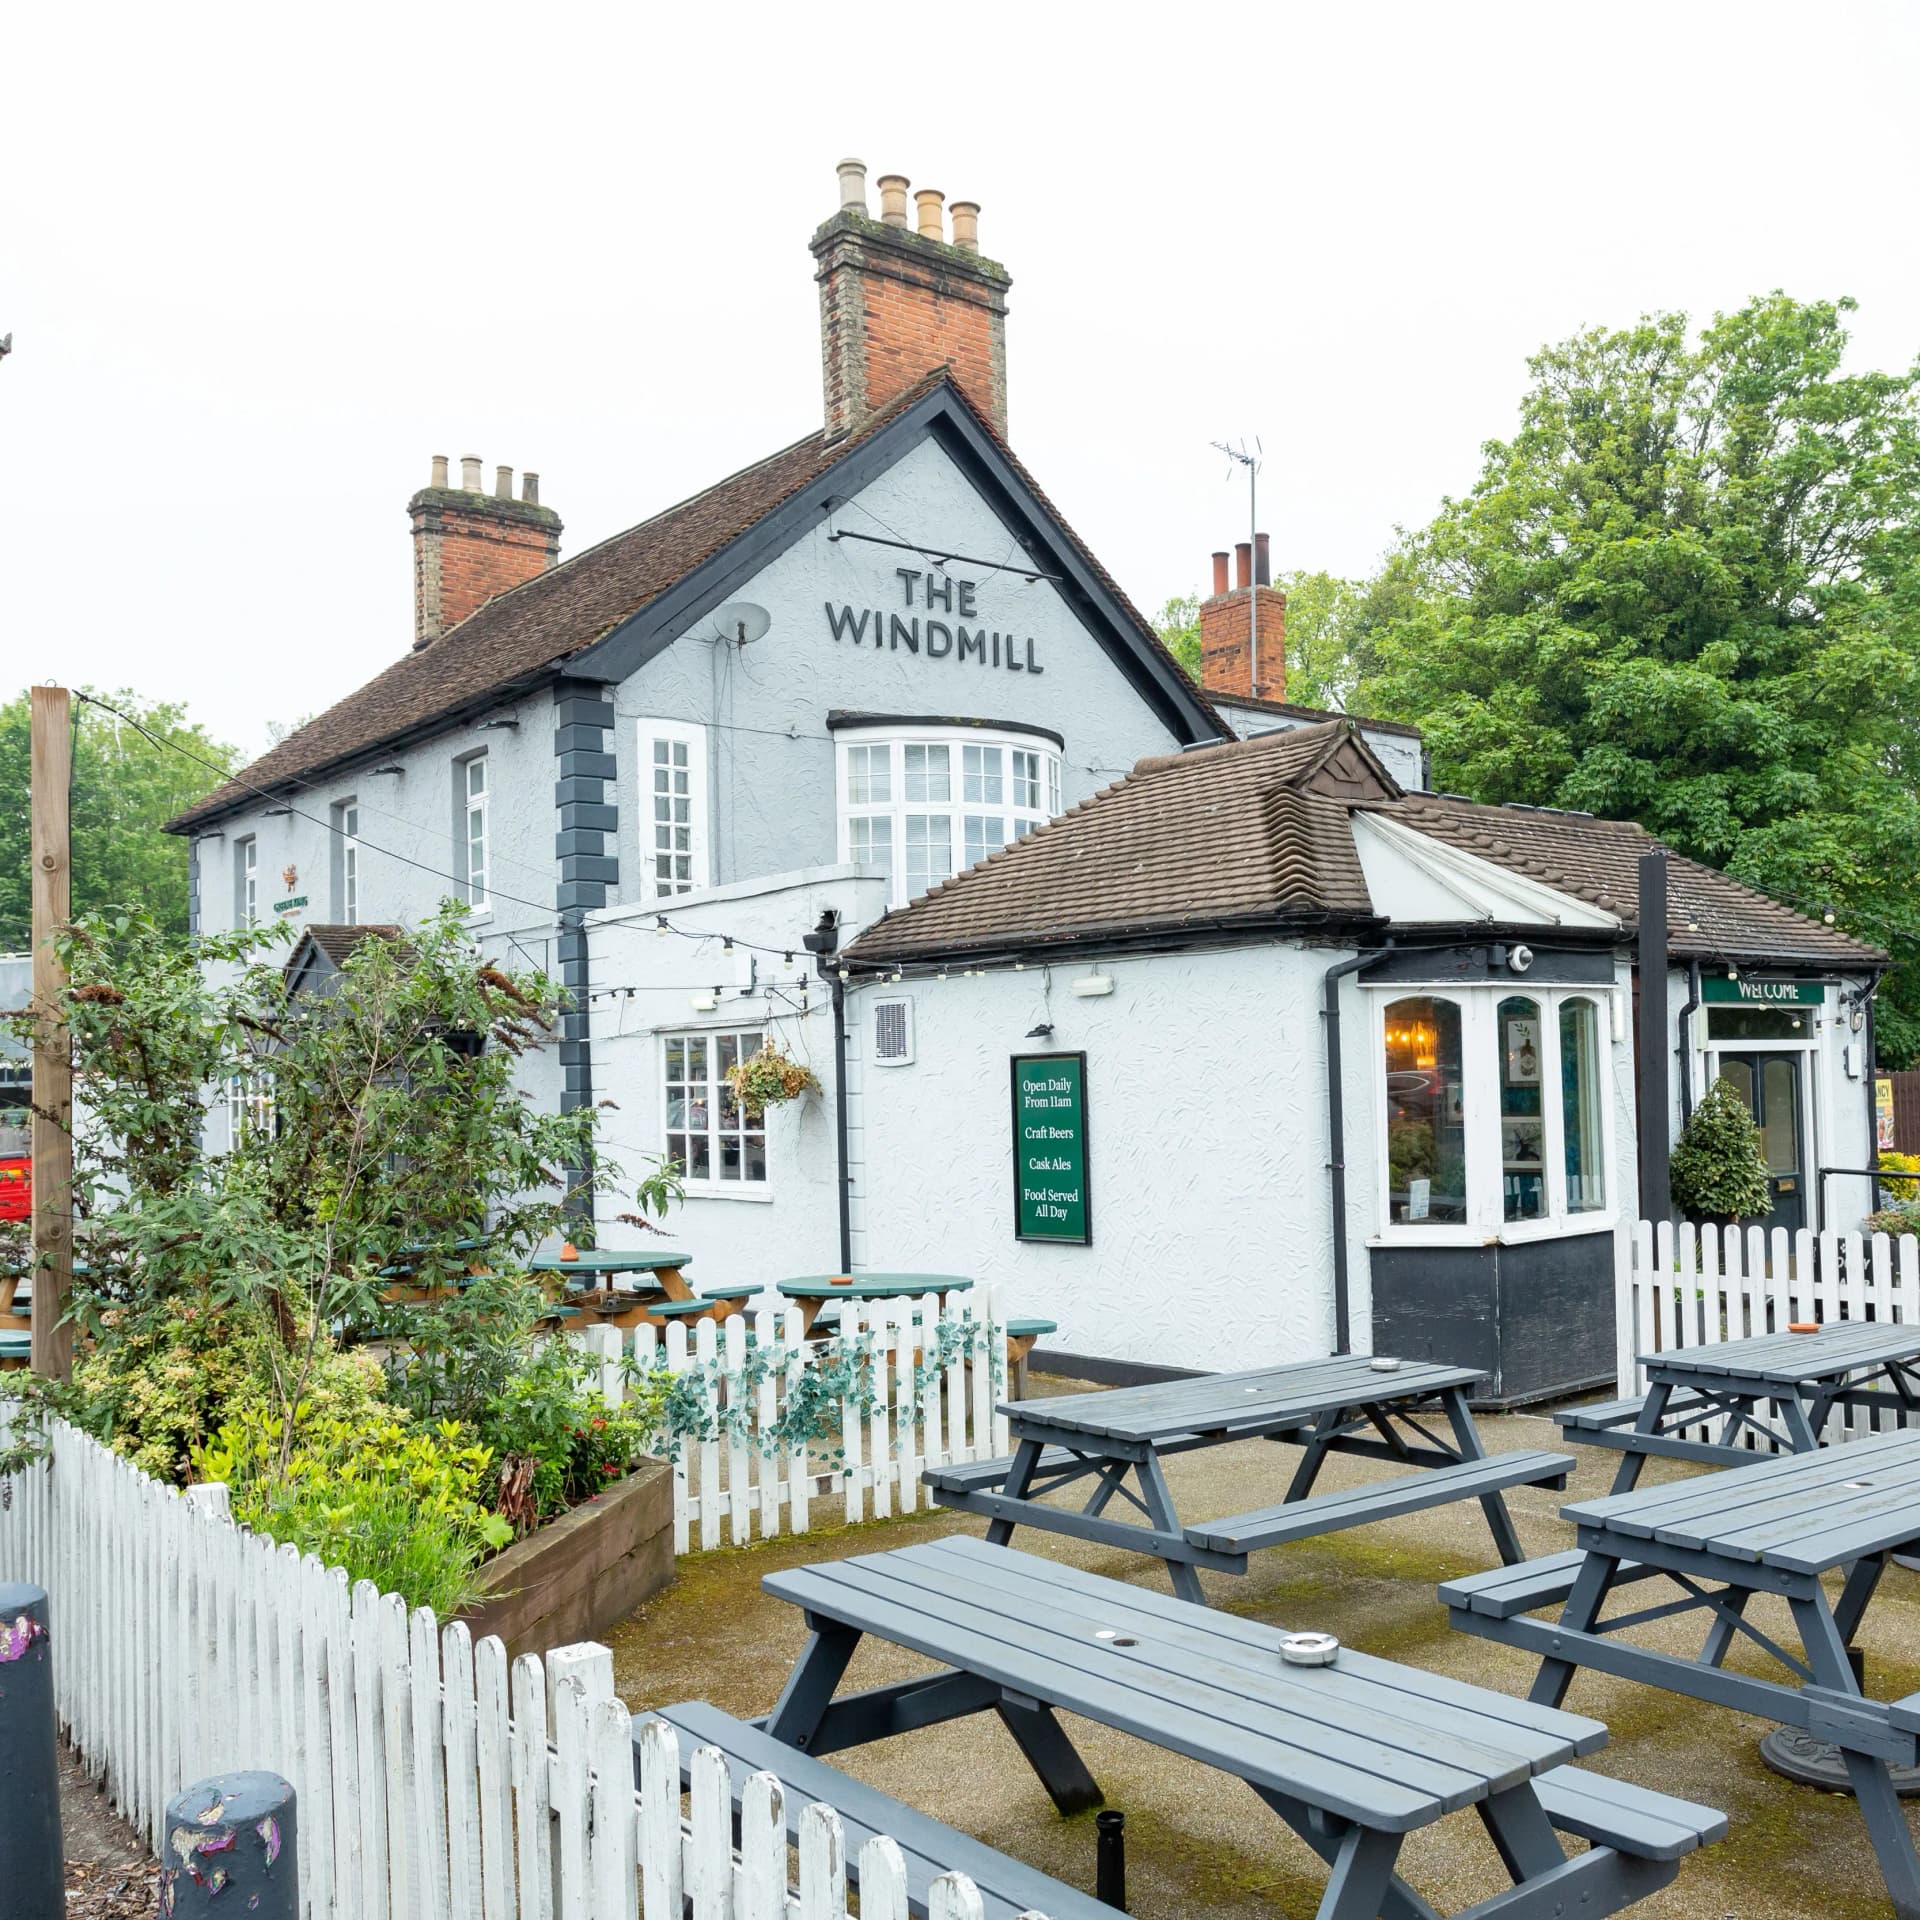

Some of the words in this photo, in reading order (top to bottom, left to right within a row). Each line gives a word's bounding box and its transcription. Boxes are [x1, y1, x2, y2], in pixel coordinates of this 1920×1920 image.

[896, 567, 978, 618] THE
[824, 601, 1045, 675] WINDMILL
[1737, 980, 1800, 1000] WELCOME
[1022, 1079, 1047, 1095] Open
[1047, 1077, 1072, 1094] Daily
[1024, 1096, 1049, 1108] From
[1050, 1095, 1072, 1107] 11am
[1024, 1125, 1048, 1139] Craft
[1048, 1126, 1074, 1139] Beers
[1029, 1156, 1051, 1170] Cask
[1051, 1156, 1072, 1170] Ales
[1023, 1188, 1047, 1201] Food
[1047, 1188, 1079, 1202] Served
[1034, 1203, 1049, 1217] All
[1049, 1205, 1068, 1222] Day
